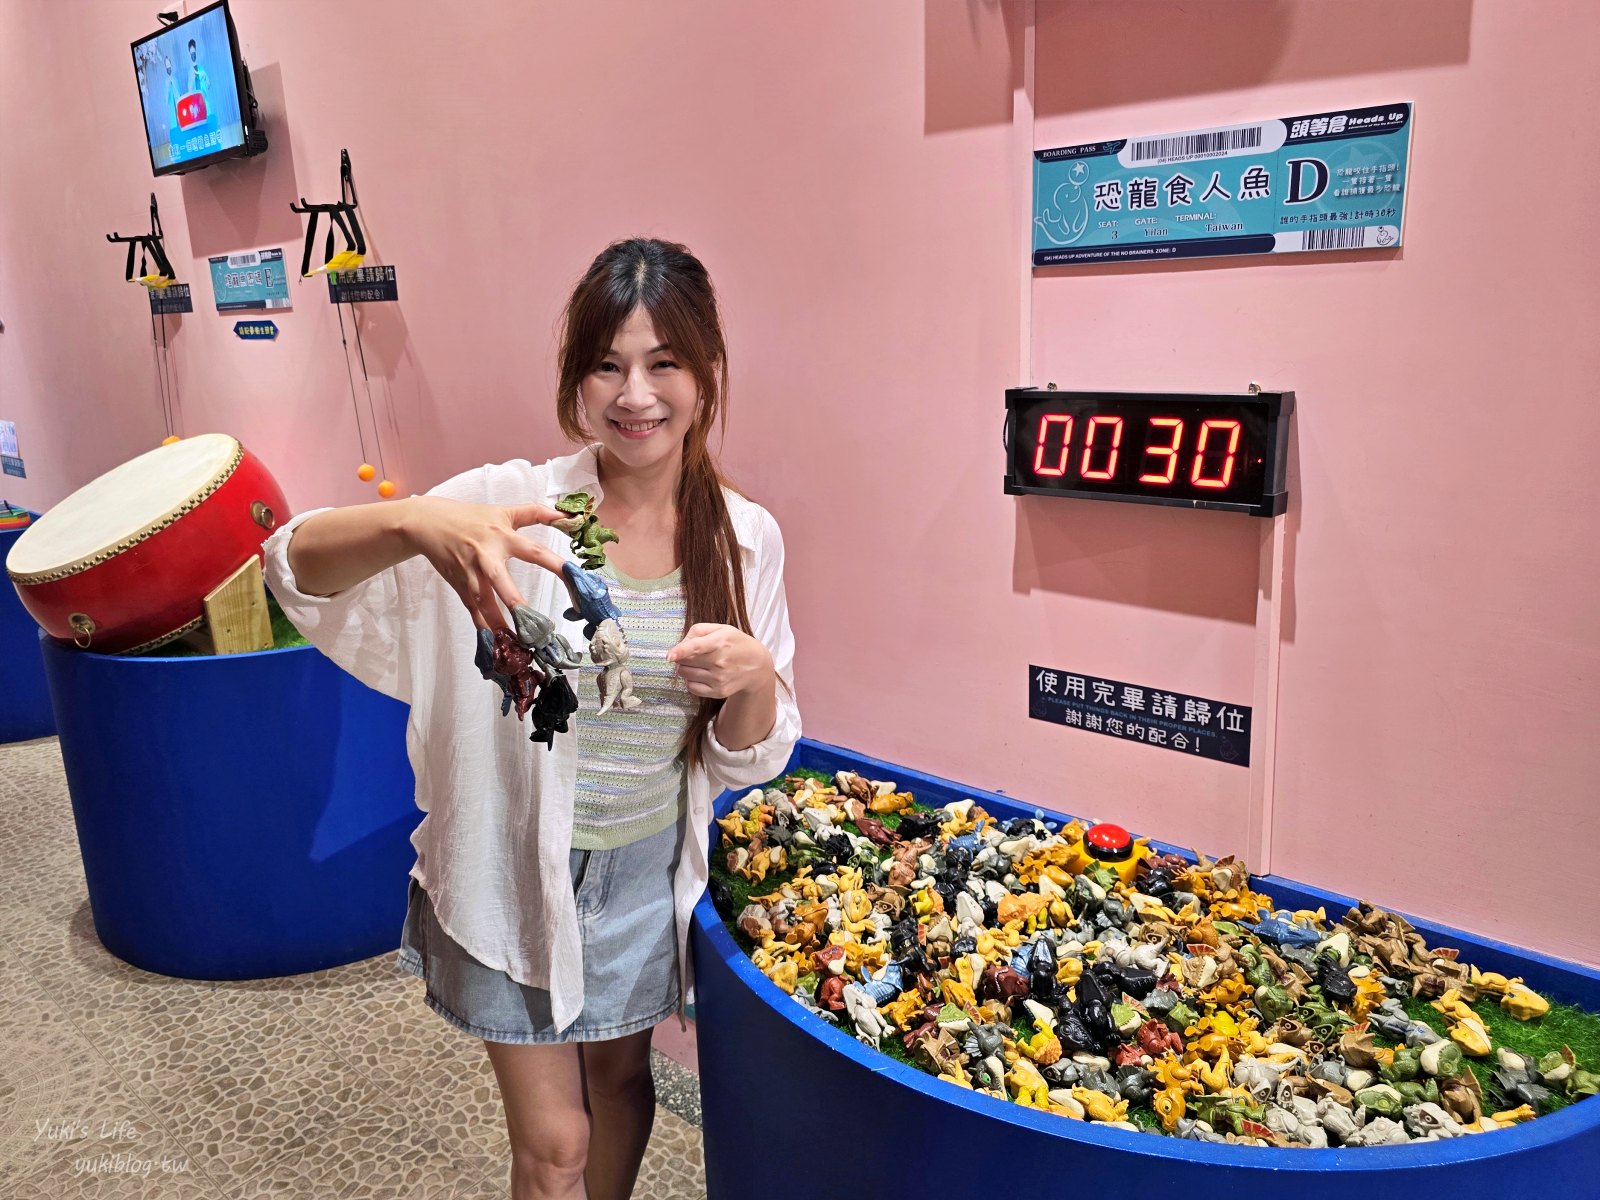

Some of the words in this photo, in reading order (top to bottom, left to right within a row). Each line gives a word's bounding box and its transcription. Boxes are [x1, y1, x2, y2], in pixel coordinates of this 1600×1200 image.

[1289, 115, 1348, 139] 頭等倉
[1348, 115, 1385, 126] Heads
[1388, 113, 1404, 122] Up
[1043, 148, 1077, 158] BOARDING
[1080, 145, 1096, 154] PASS
[1094, 166, 1270, 211] 恐龍食人魚
[1283, 157, 1331, 206] D
[1098, 220, 1119, 229] SEAT:
[1134, 217, 1158, 225] GATE:
[1175, 213, 1217, 222] TERMINAL:
[1111, 230, 1118, 240] 3
[1144, 228, 1168, 237] Yilan
[1204, 222, 1243, 232] Taiwan
[1035, 669, 1245, 734] 使用完畢請歸位
[1048, 696, 1071, 707] PLEASE
[1072, 702, 1084, 710] PUT
[1086, 704, 1109, 715] THINGS
[1111, 711, 1128, 719] BACK
[1138, 716, 1158, 724] THEIR
[1159, 720, 1187, 731] PROPER
[1065, 707, 1200, 752] 謝謝您的配合!
